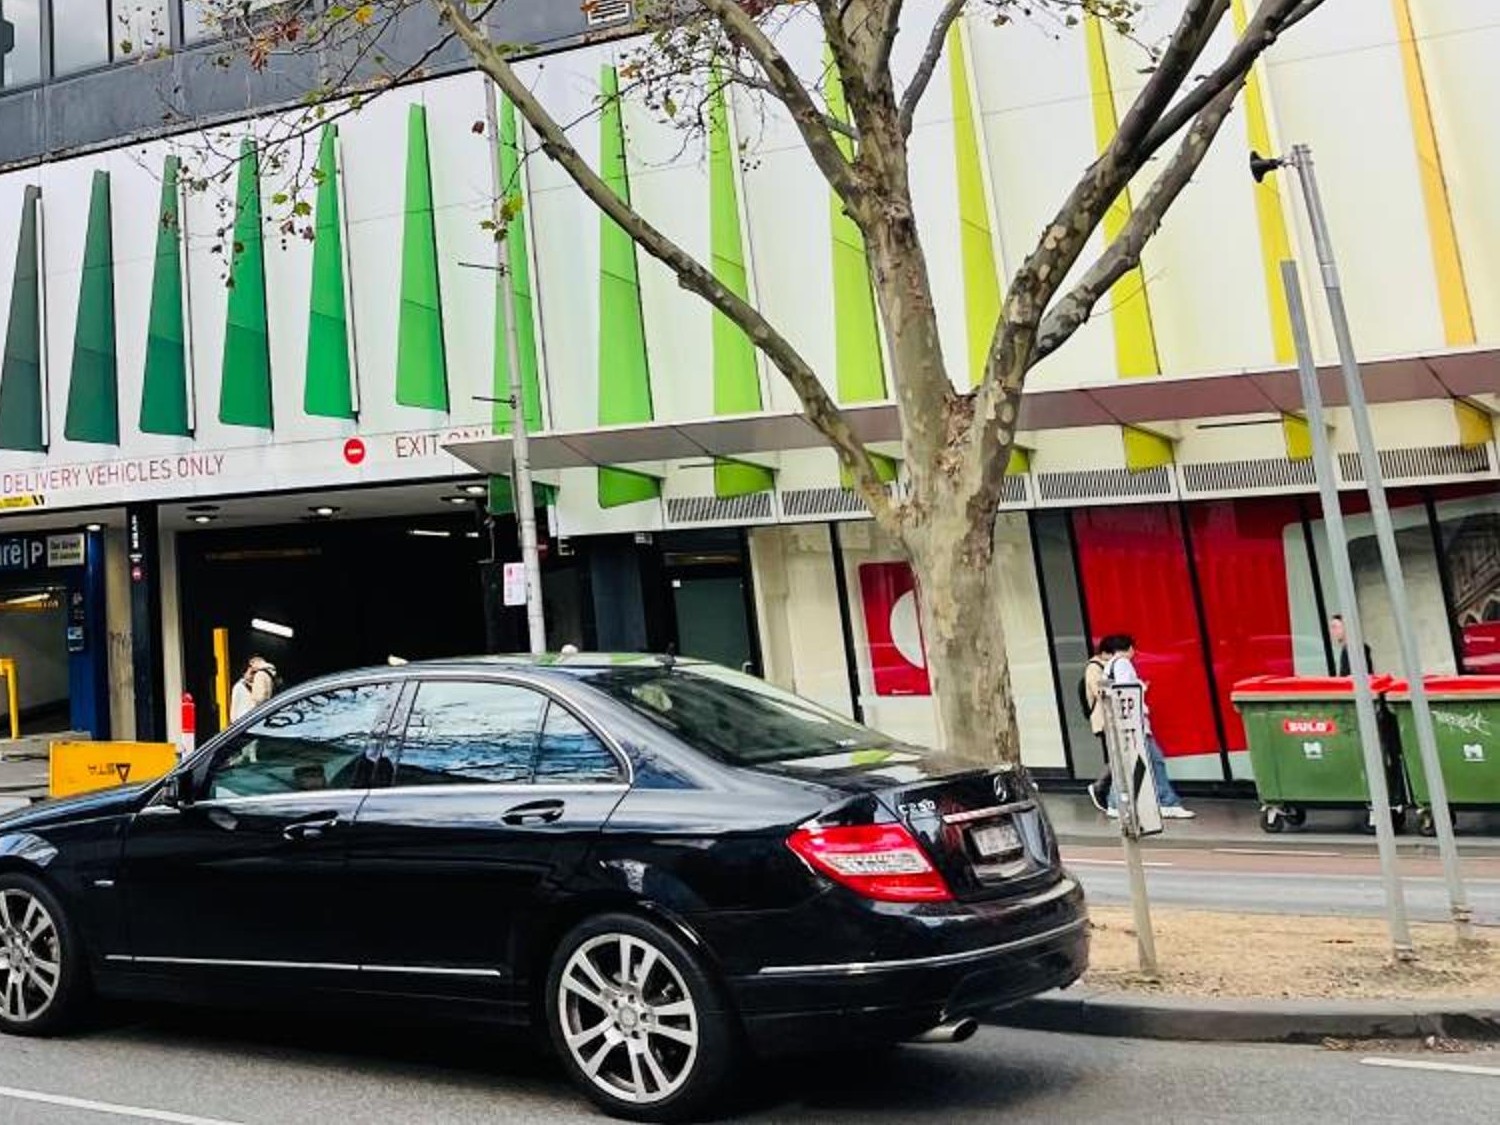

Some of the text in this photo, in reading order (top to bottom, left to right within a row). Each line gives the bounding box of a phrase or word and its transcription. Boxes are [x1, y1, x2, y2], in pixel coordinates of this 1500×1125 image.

[395, 434, 440, 459] EXIT
[2, 454, 226, 495] DELIVERY VEHICLES ONLY
